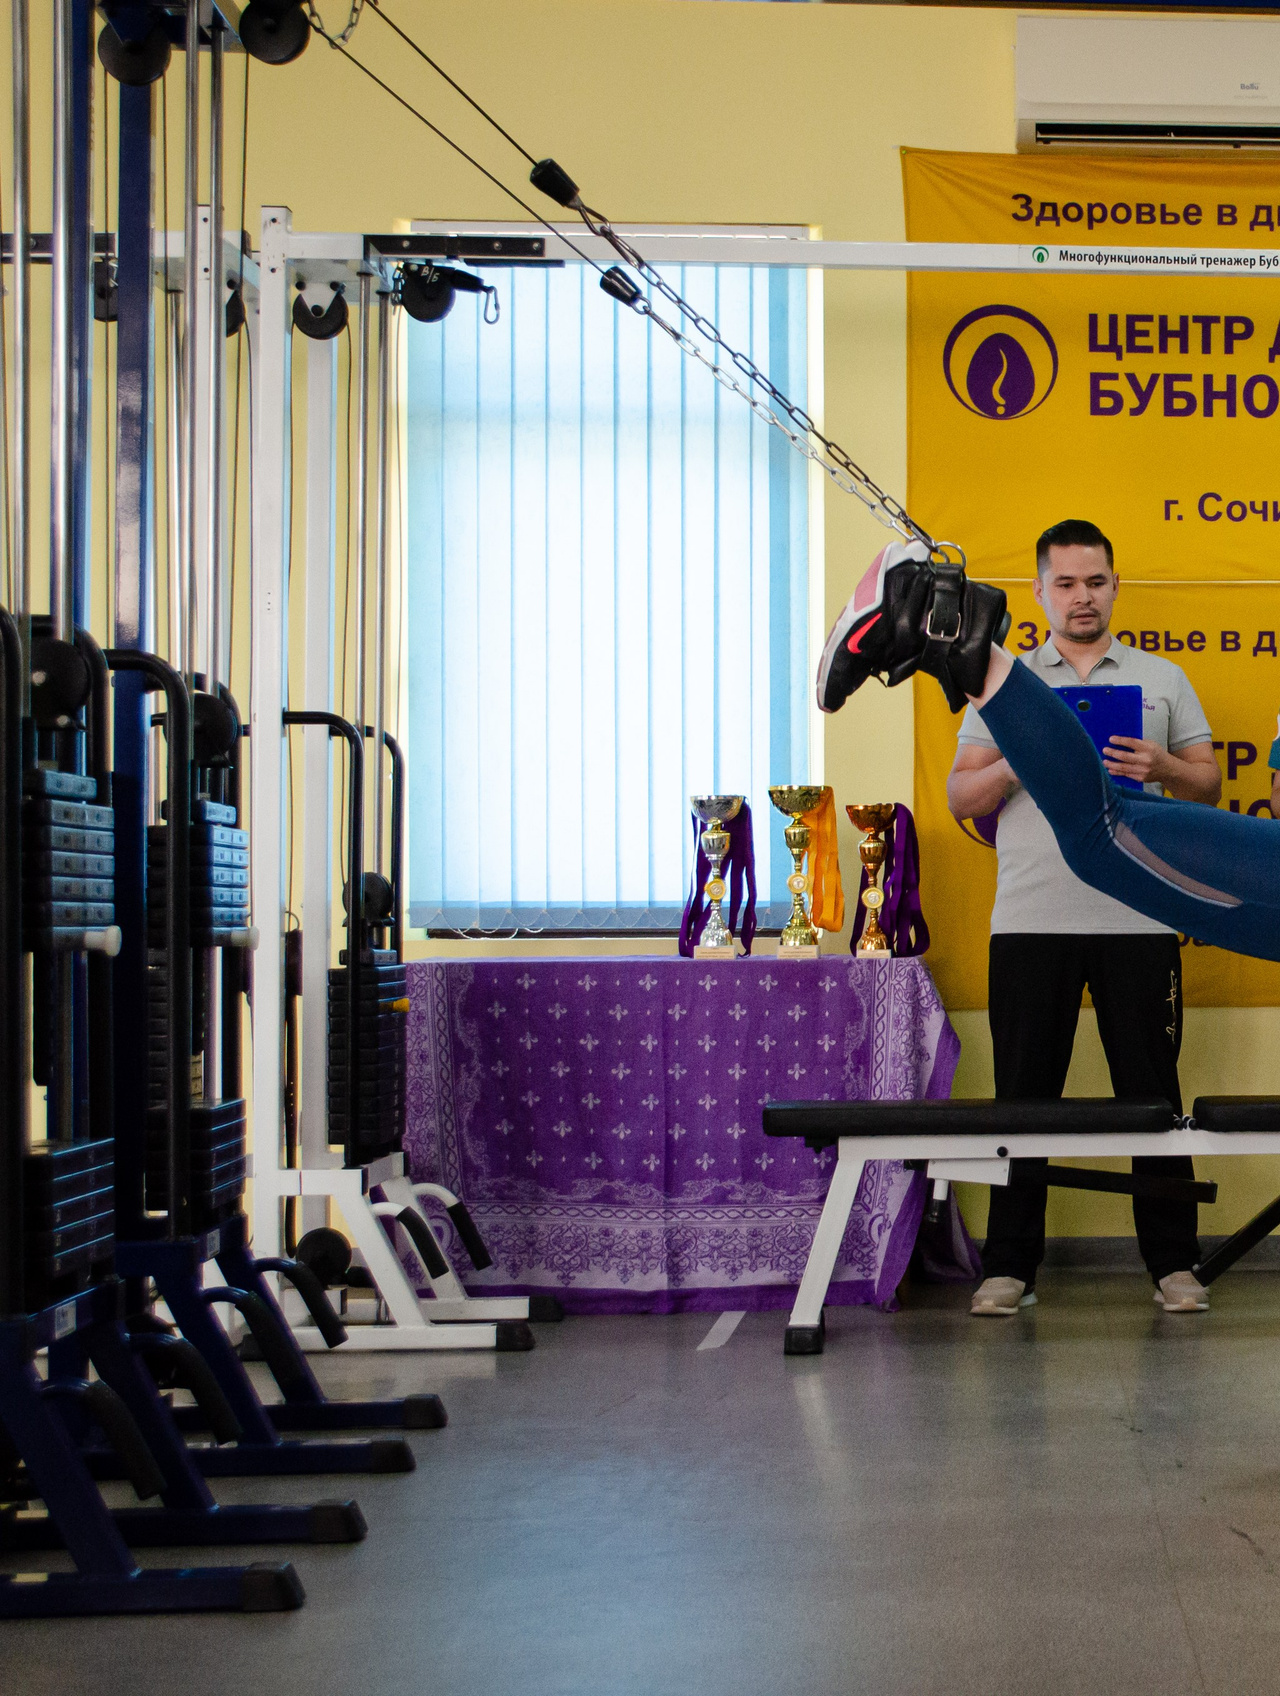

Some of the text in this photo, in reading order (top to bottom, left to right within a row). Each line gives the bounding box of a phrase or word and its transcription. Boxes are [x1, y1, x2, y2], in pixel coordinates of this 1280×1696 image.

[1012, 193, 1204, 231] Здоровье
[1217, 204, 1239, 227] в
[1059, 249, 1198, 266] Многофункциональный
[1200, 256, 1256, 269] тренажер
[1088, 313, 1255, 361] ЦЕНТР
[1165, 500, 1190, 522] г.
[1222, 632, 1242, 653] в
